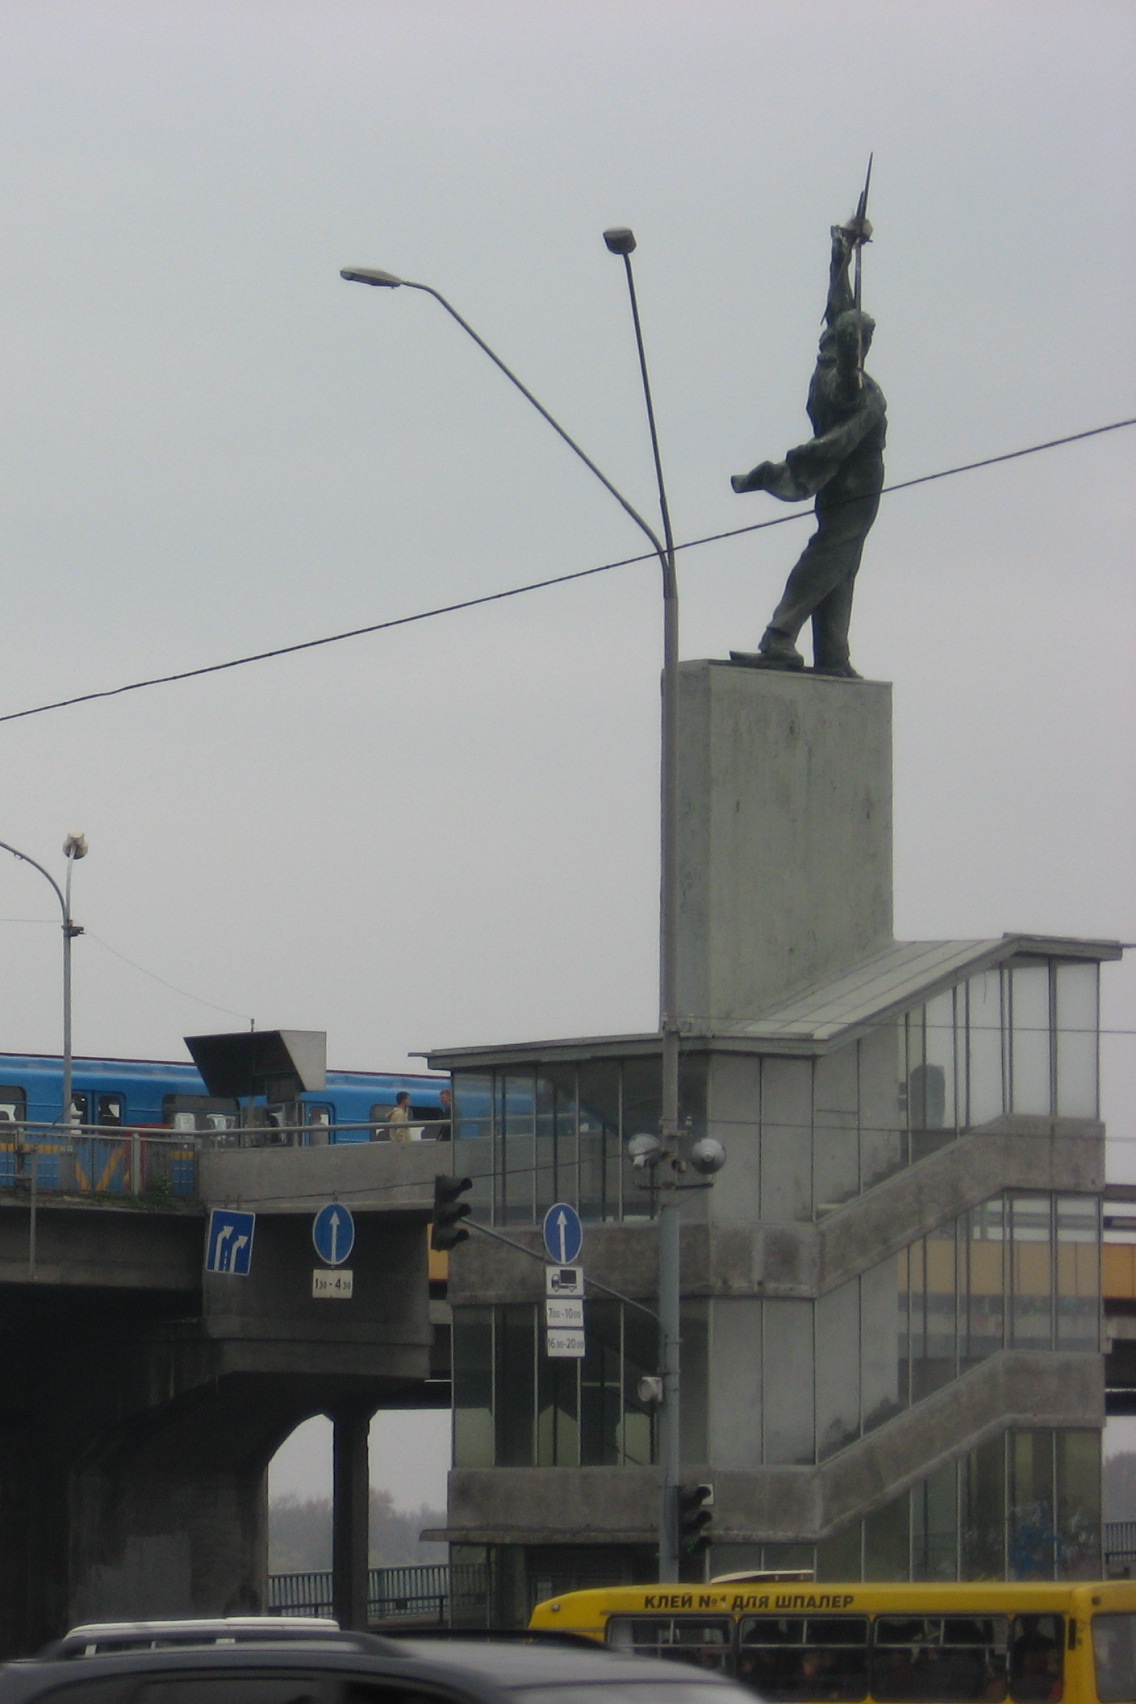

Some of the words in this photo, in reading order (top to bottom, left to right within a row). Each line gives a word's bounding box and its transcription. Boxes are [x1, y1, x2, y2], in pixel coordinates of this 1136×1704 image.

[644, 1592, 693, 1609] КЛЕЙ
[731, 1595, 769, 1611] ДЛЯ
[775, 1595, 854, 1609] ШПАЛЕР
